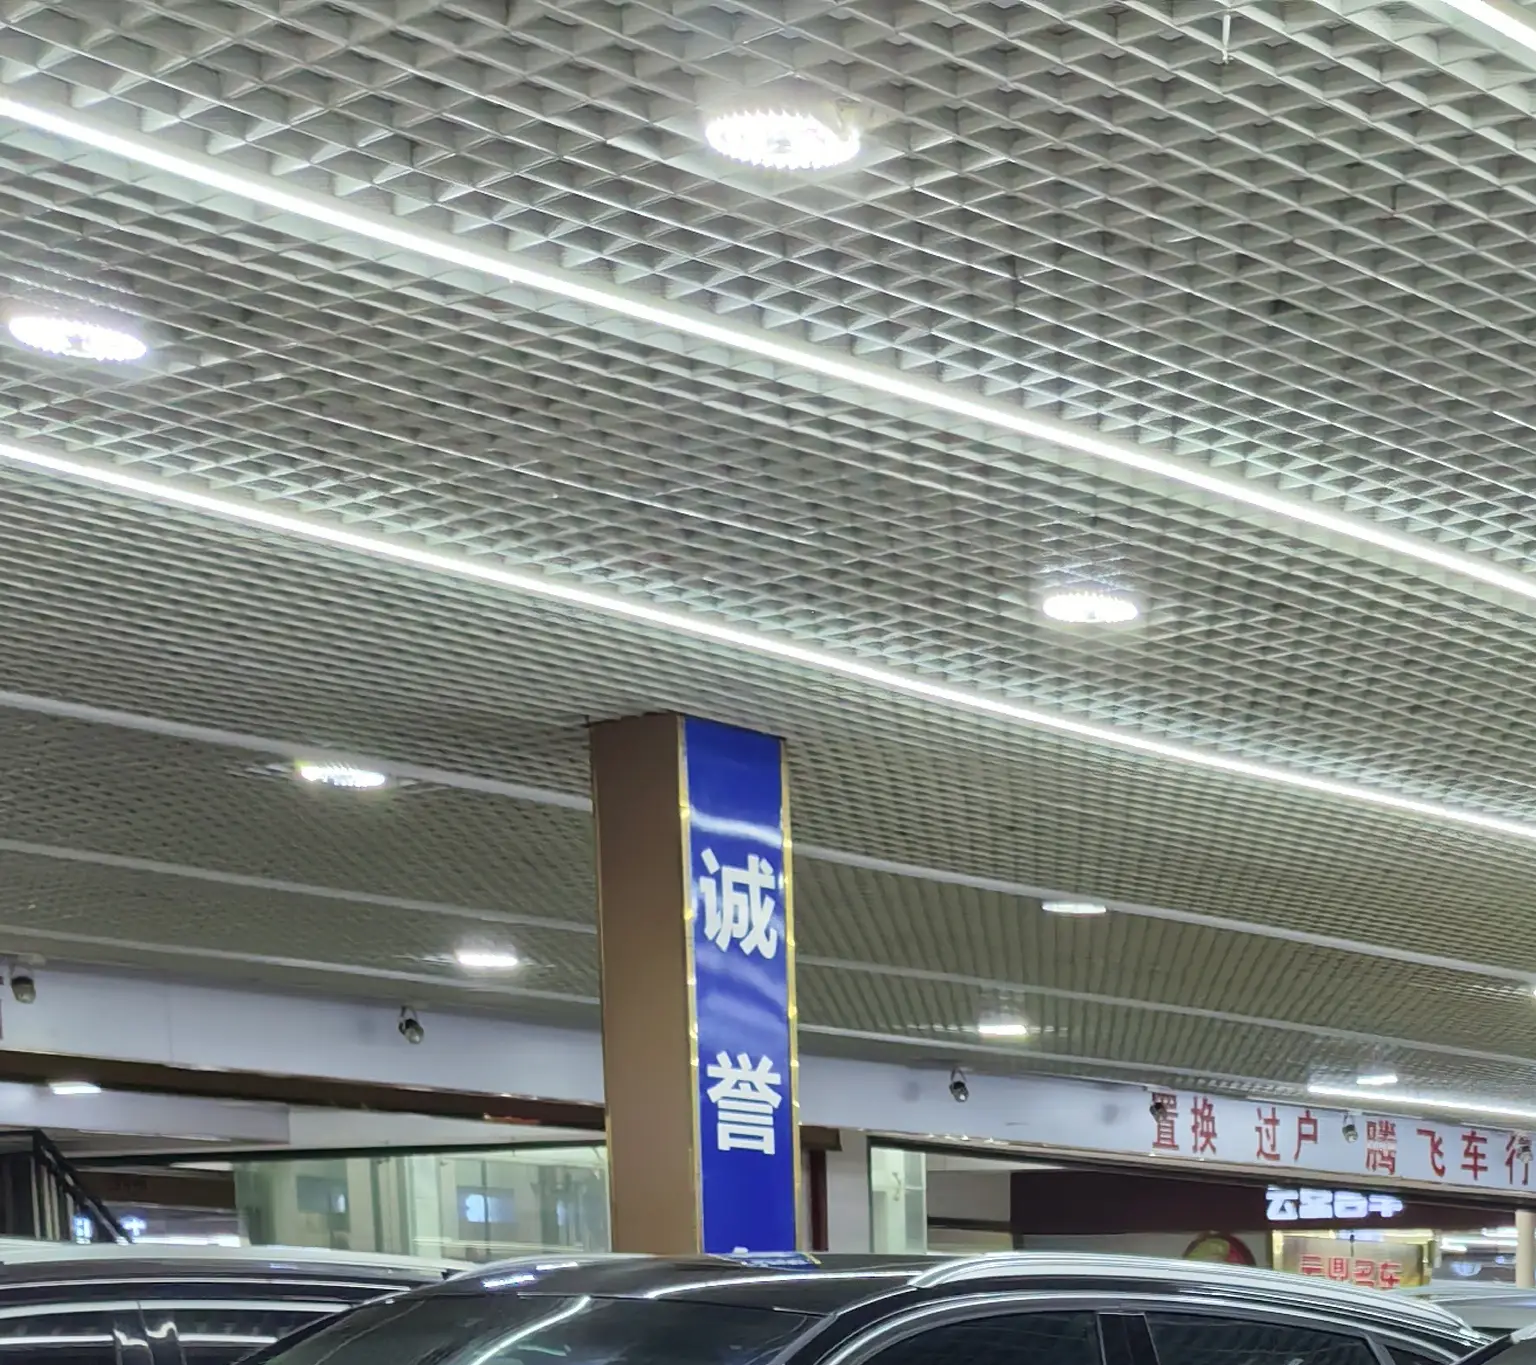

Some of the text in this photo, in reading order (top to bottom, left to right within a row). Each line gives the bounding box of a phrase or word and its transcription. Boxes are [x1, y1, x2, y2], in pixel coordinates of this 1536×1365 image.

[700, 848, 784, 1254] 诚誉
[1151, 1092, 1218, 1154] 置换
[1255, 1106, 1318, 1162] 过户
